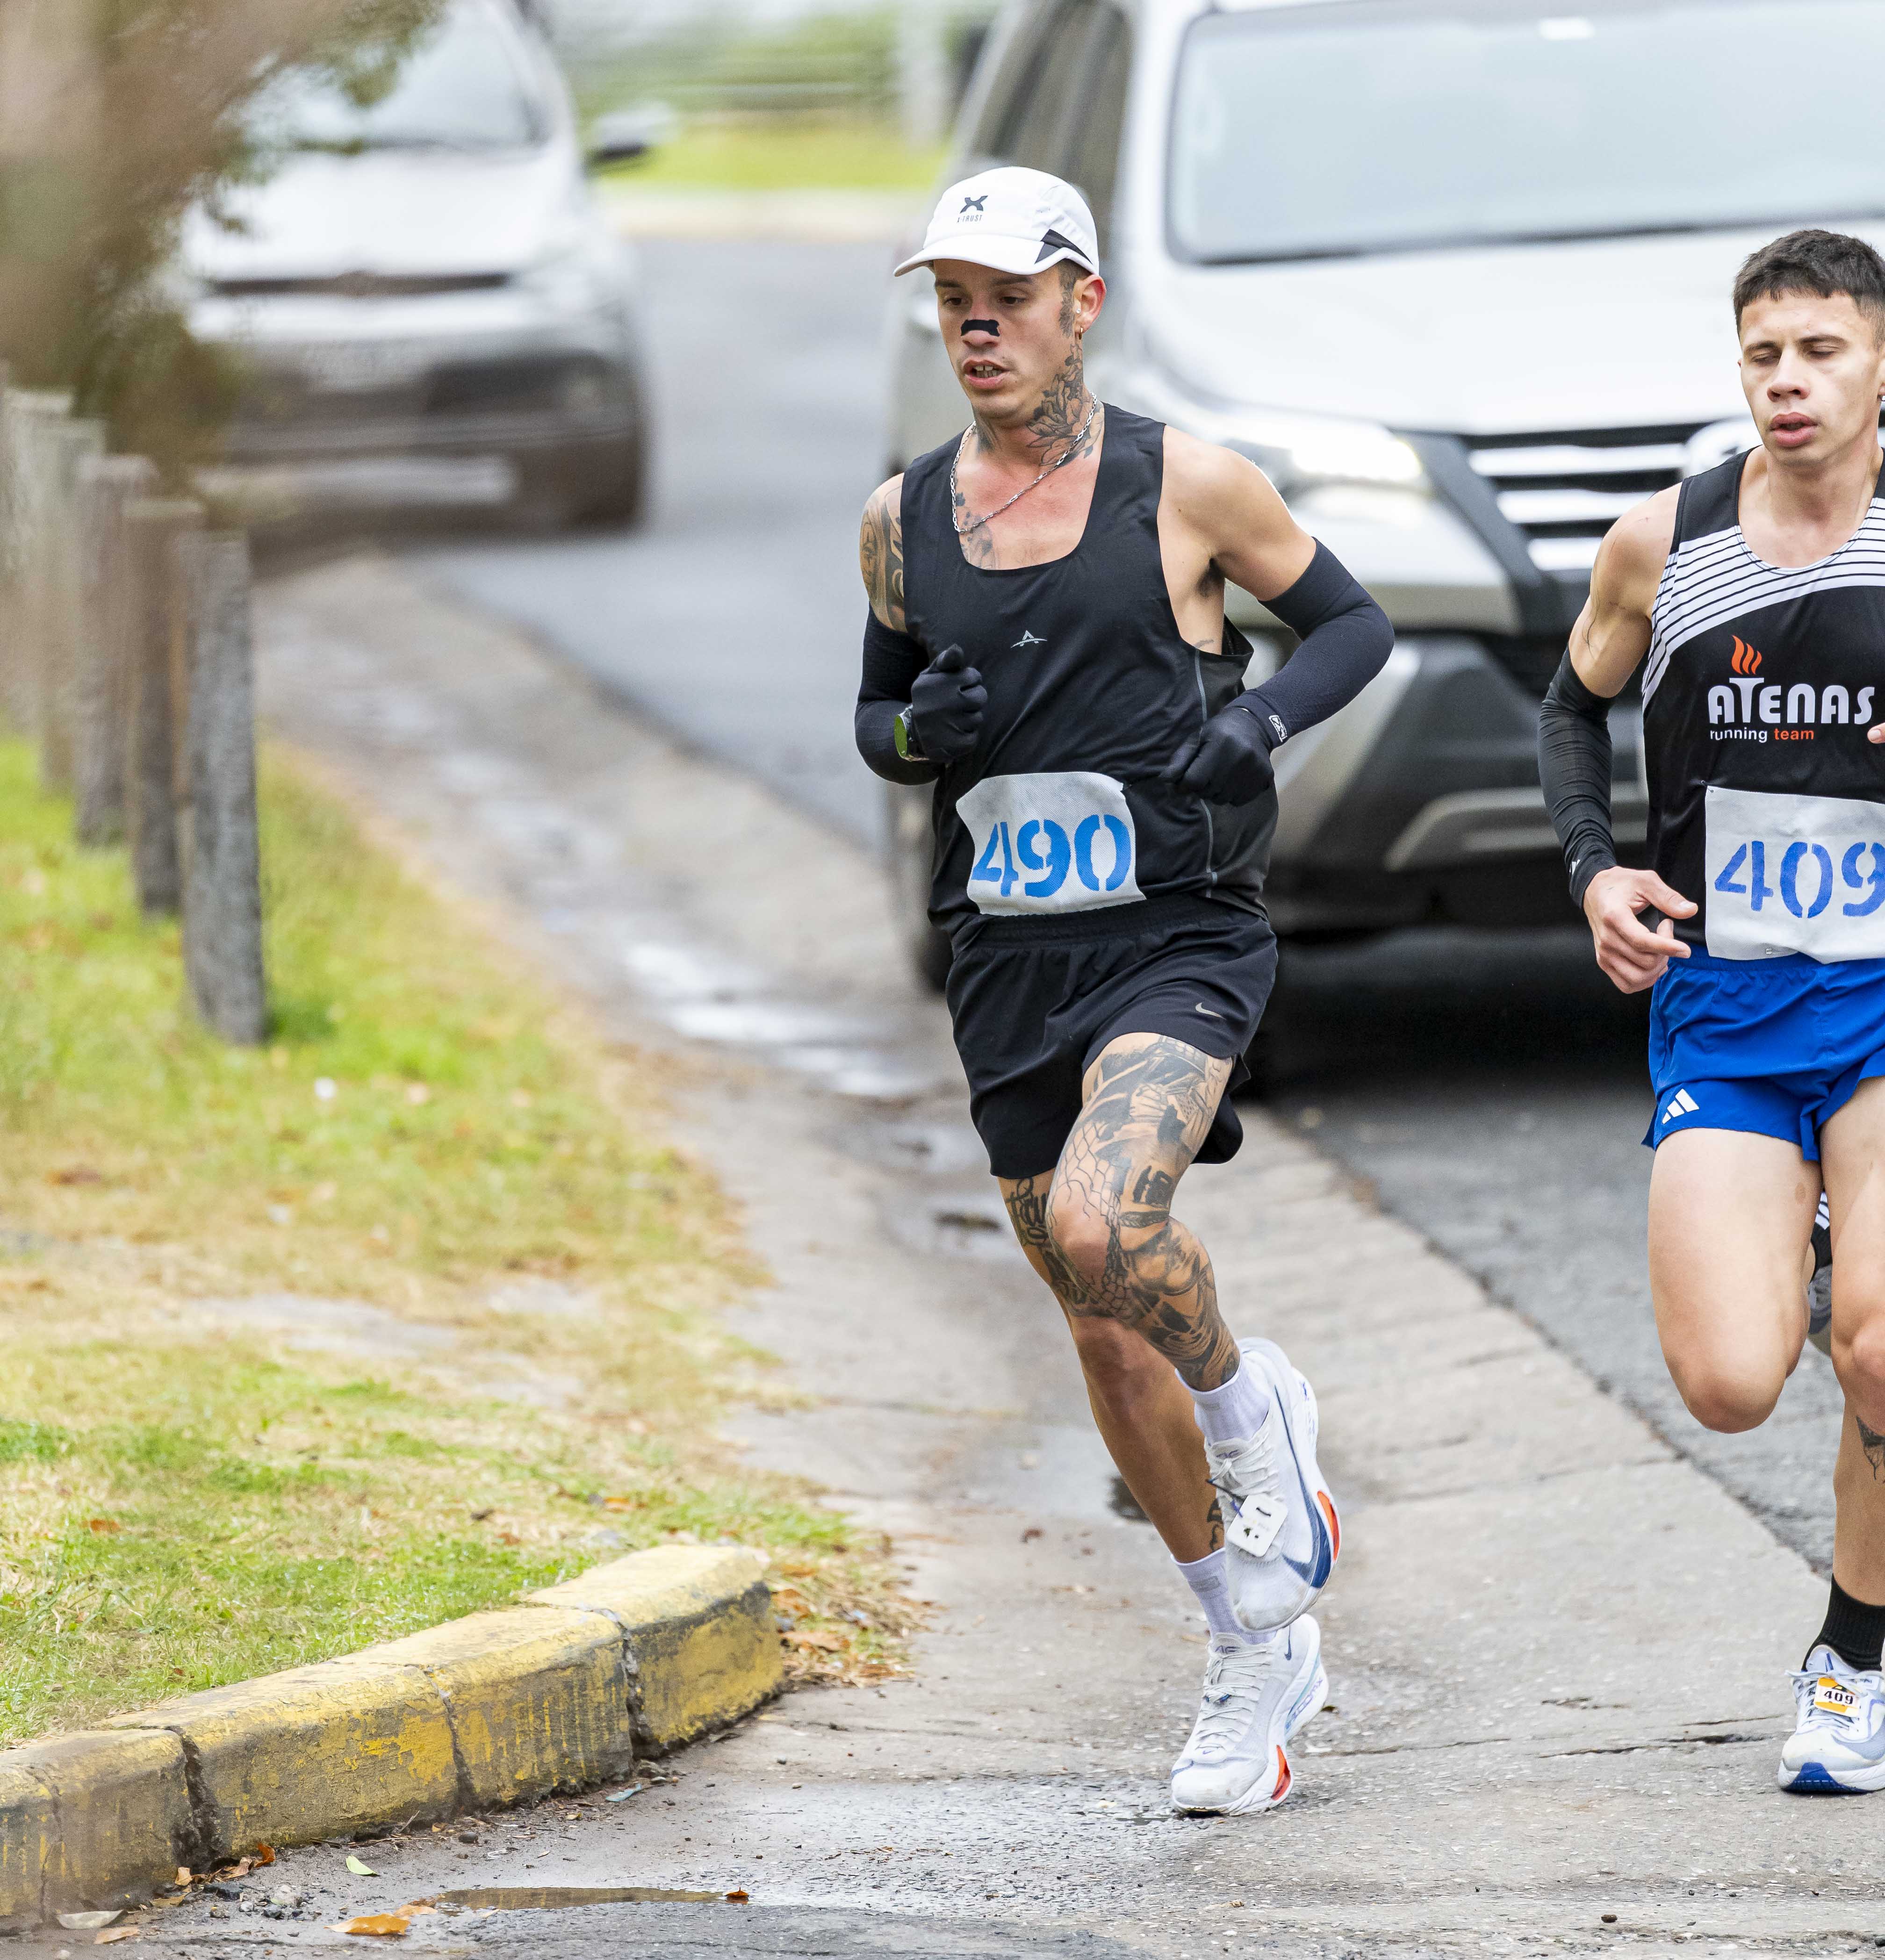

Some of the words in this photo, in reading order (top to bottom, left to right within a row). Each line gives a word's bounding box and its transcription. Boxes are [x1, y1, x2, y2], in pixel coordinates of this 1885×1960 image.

[1708, 677, 1875, 725] ATENAS
[1710, 727, 1768, 743] running
[1774, 728, 1814, 740] team
[971, 814, 1131, 897] 490
[1714, 840, 1885, 918] 409
[1824, 1691, 1854, 1705] 409
